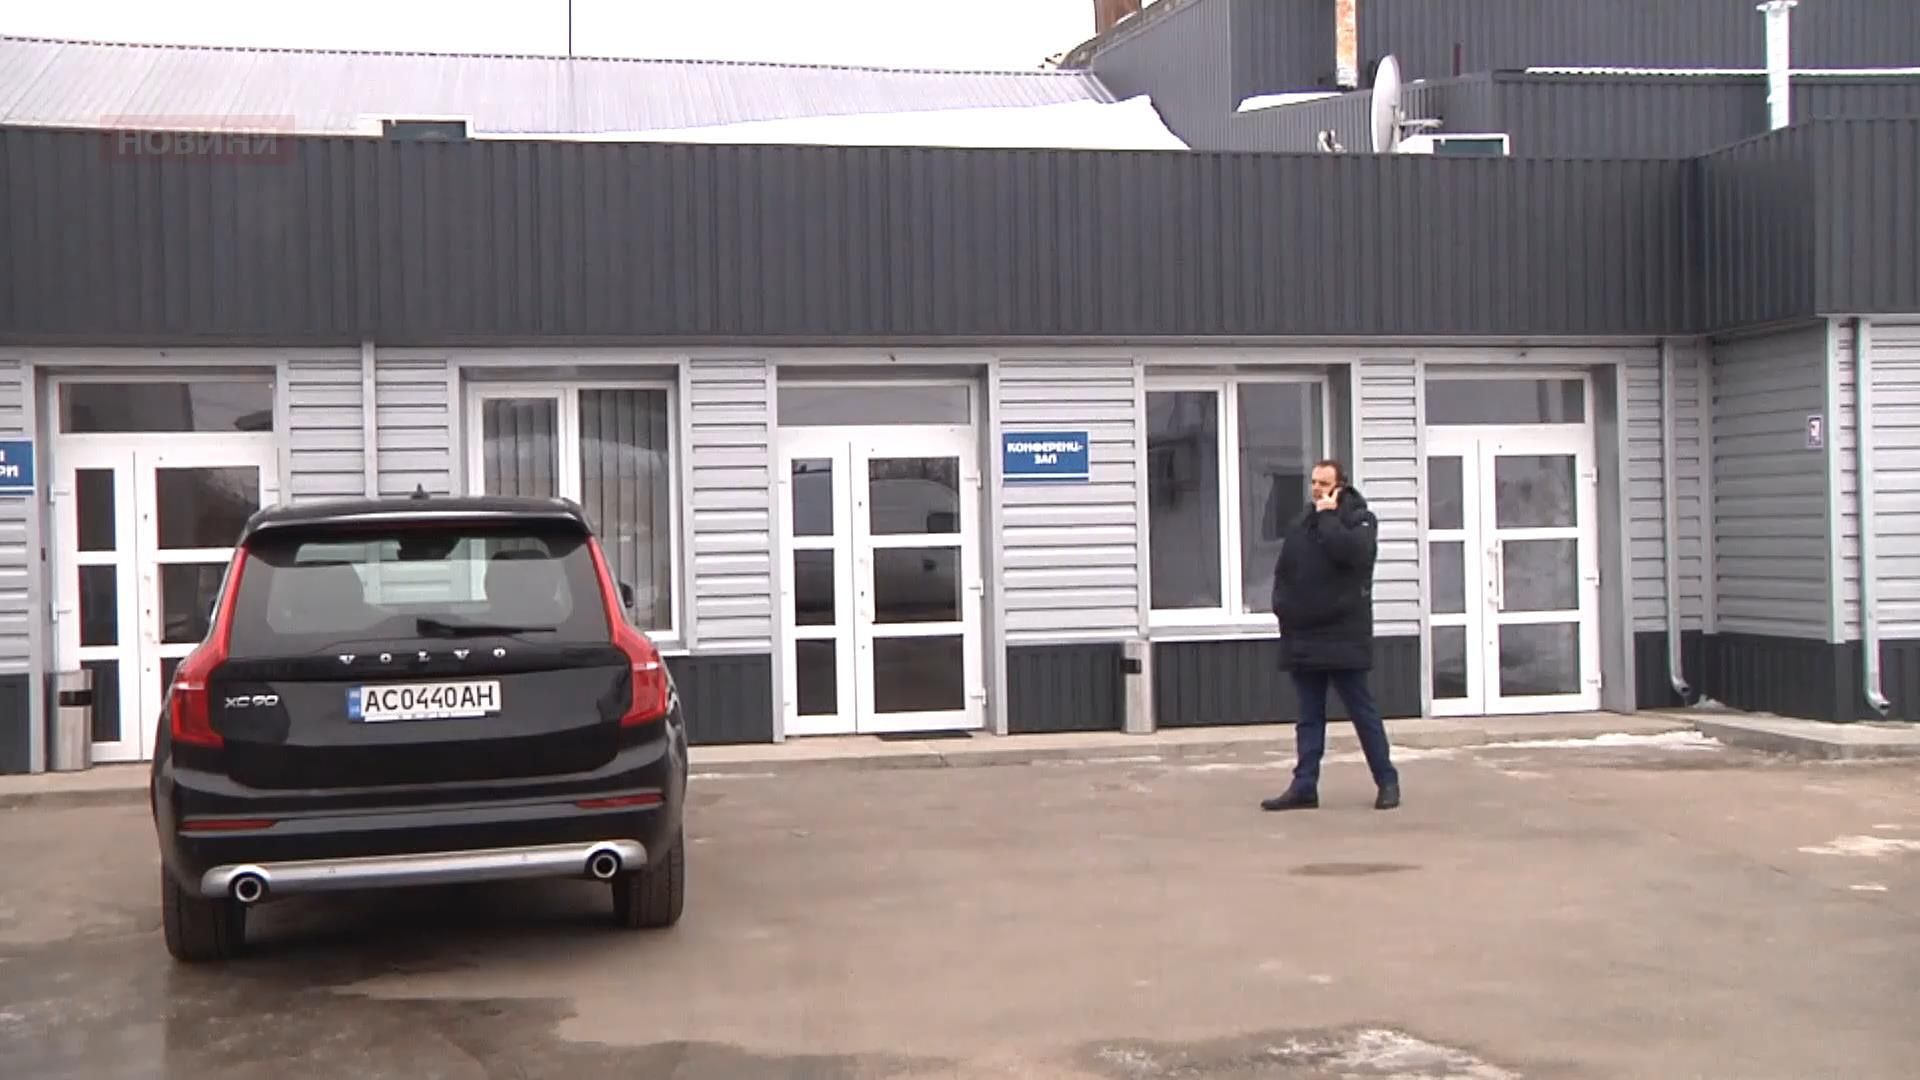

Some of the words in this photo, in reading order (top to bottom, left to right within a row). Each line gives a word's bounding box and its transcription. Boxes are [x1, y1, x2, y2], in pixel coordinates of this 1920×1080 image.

[1034, 453, 1057, 465] ЗАЛ
[339, 648, 506, 664] VOLVO
[365, 685, 494, 712] AC0440AH
